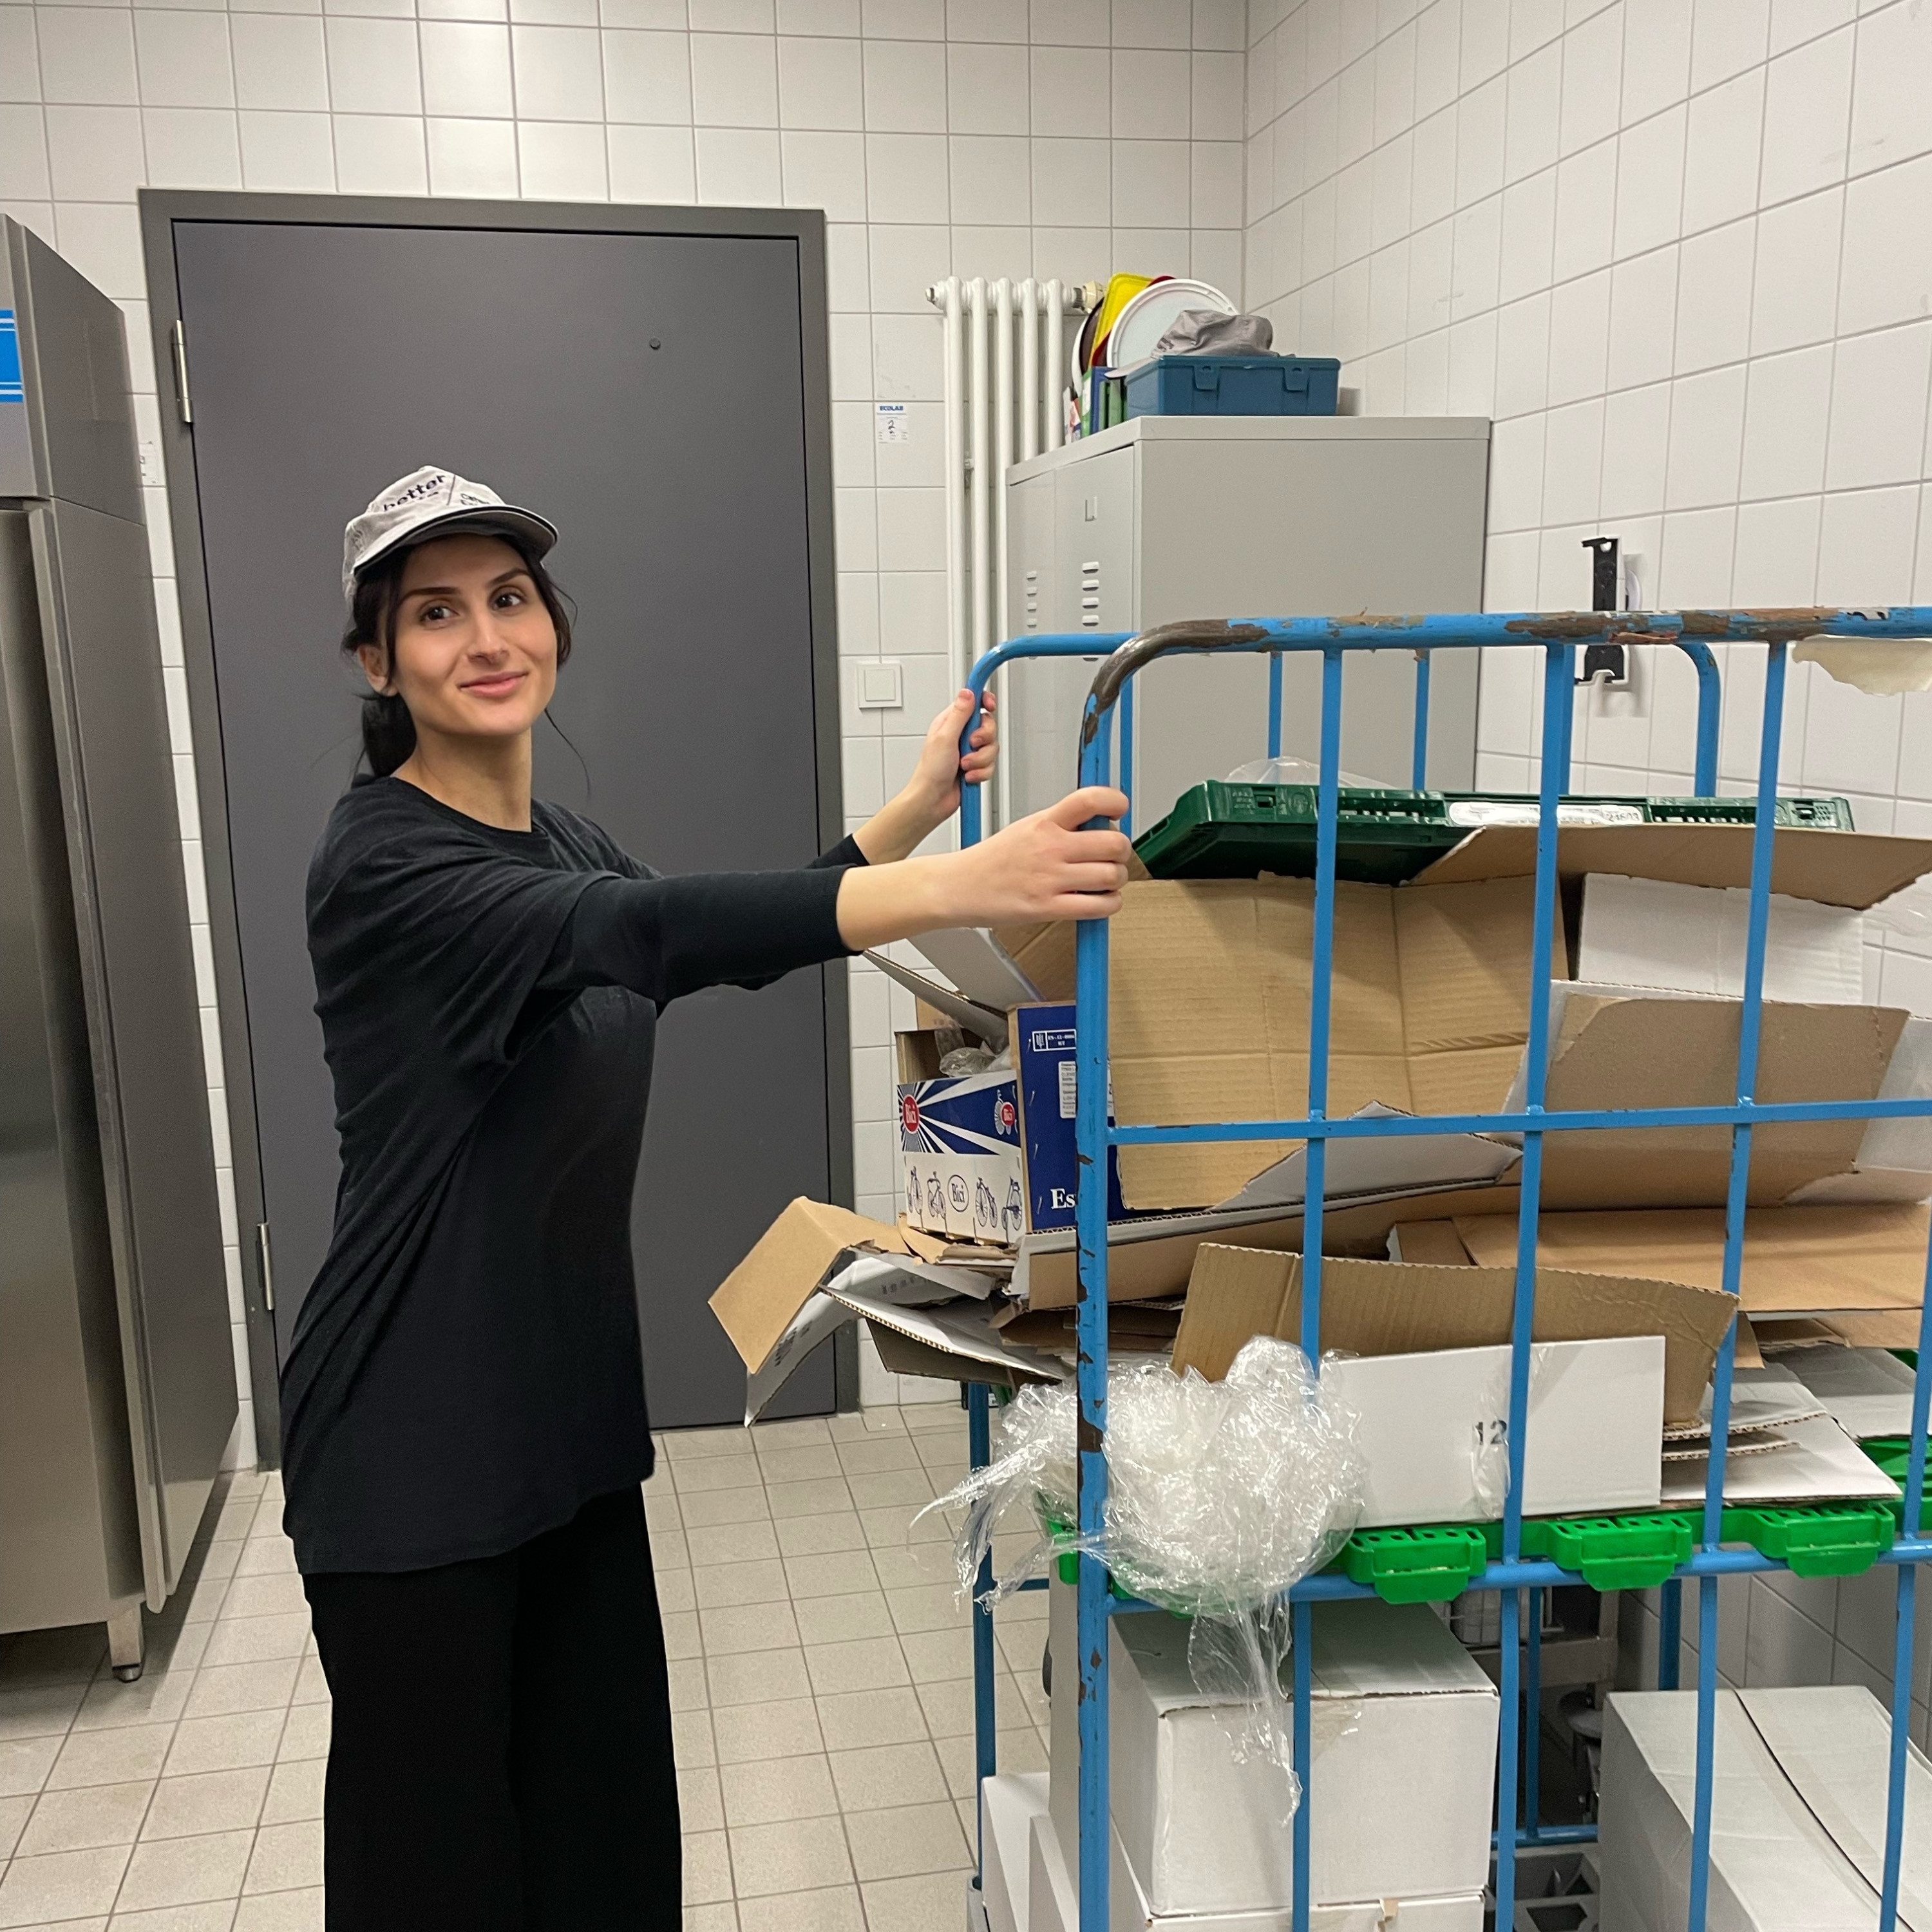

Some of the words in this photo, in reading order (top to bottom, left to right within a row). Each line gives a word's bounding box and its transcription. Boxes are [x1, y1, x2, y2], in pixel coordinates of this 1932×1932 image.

[951, 1183, 965, 1203] Bici
[1050, 1188, 1076, 1209] Es
[1474, 1419, 1508, 1445] 12
